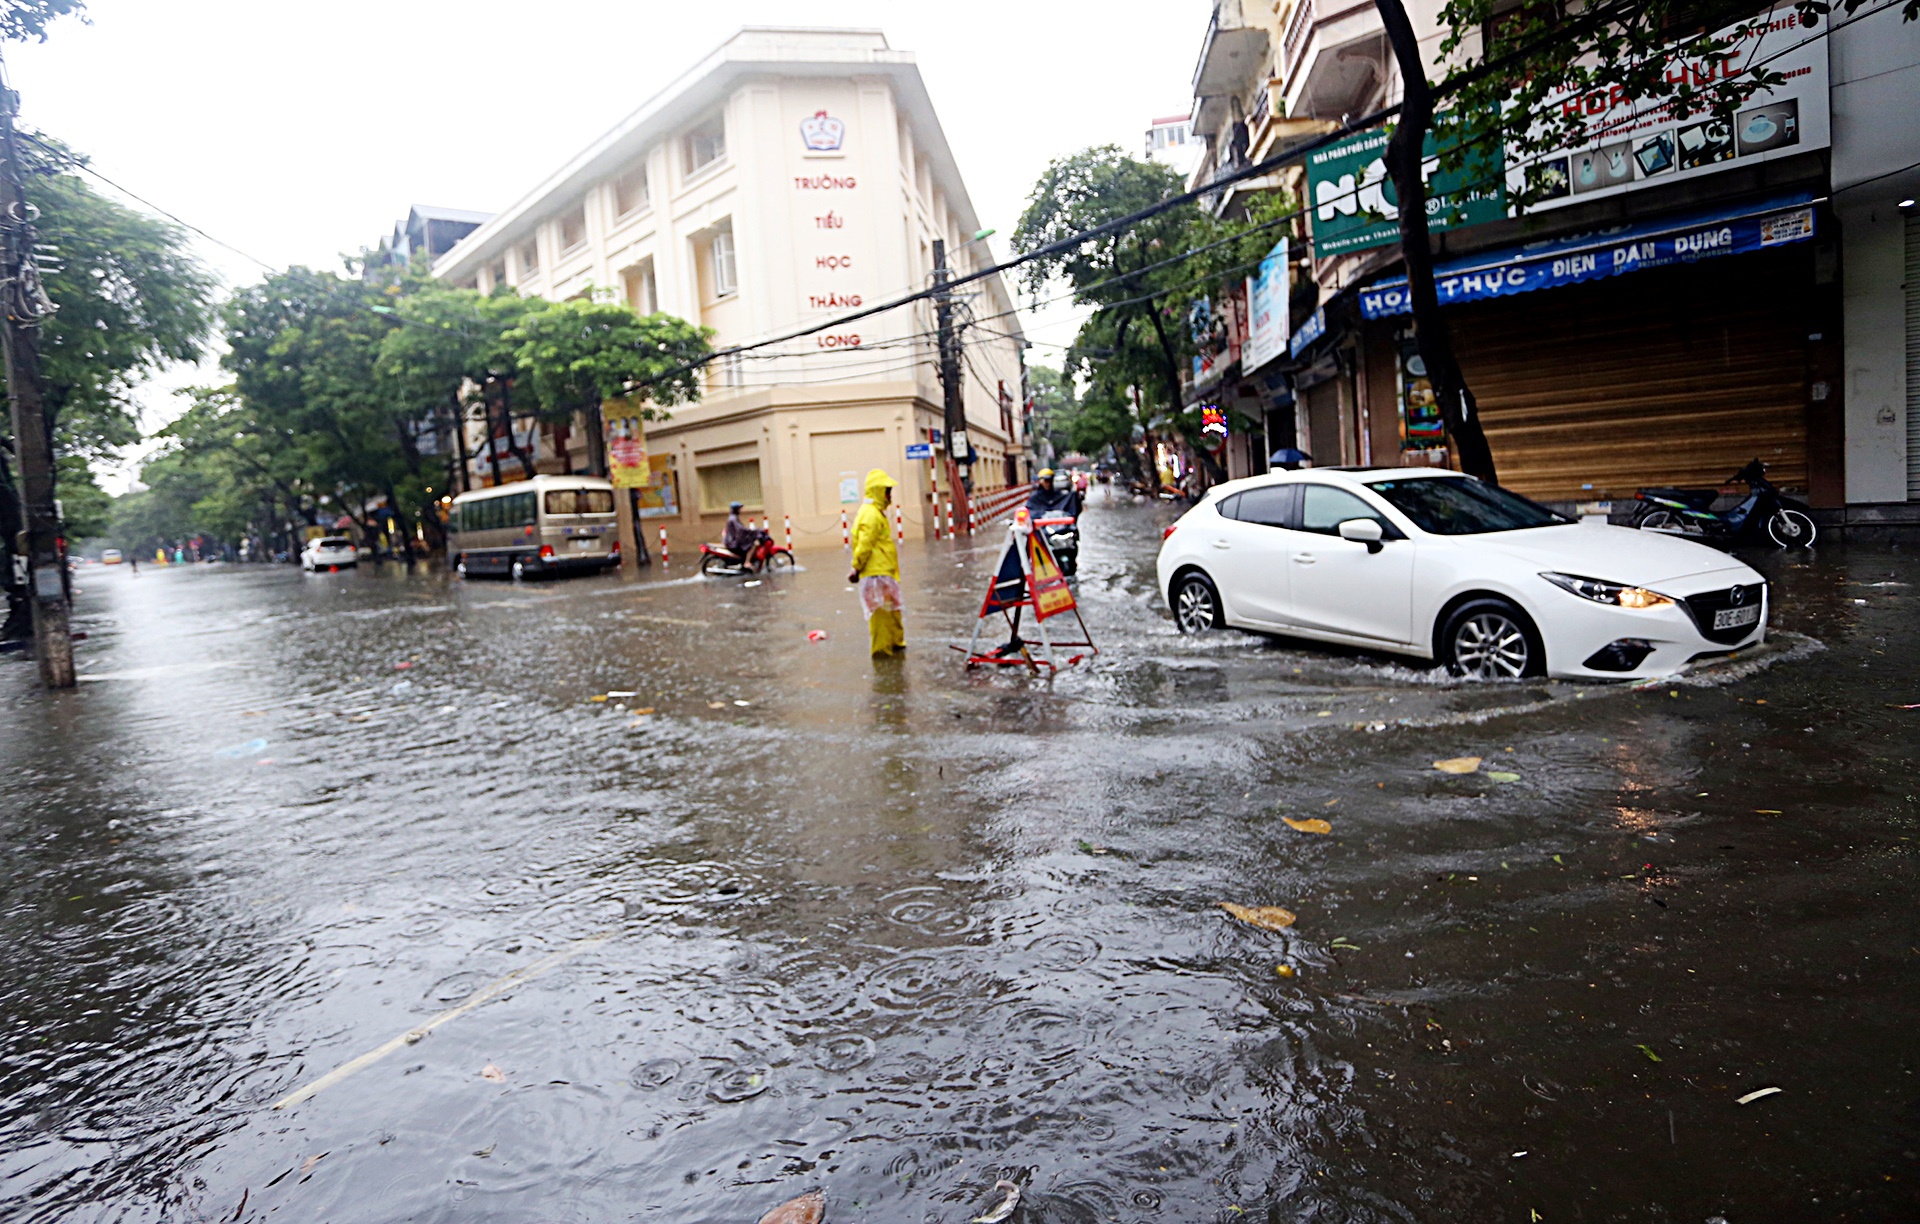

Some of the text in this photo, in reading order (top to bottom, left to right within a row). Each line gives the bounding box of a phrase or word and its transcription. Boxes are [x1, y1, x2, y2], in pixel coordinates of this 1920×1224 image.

[1674, 227, 1732, 254] DỤNG
[816, 255, 851, 271] HỌC
[817, 333, 861, 348] LONG
